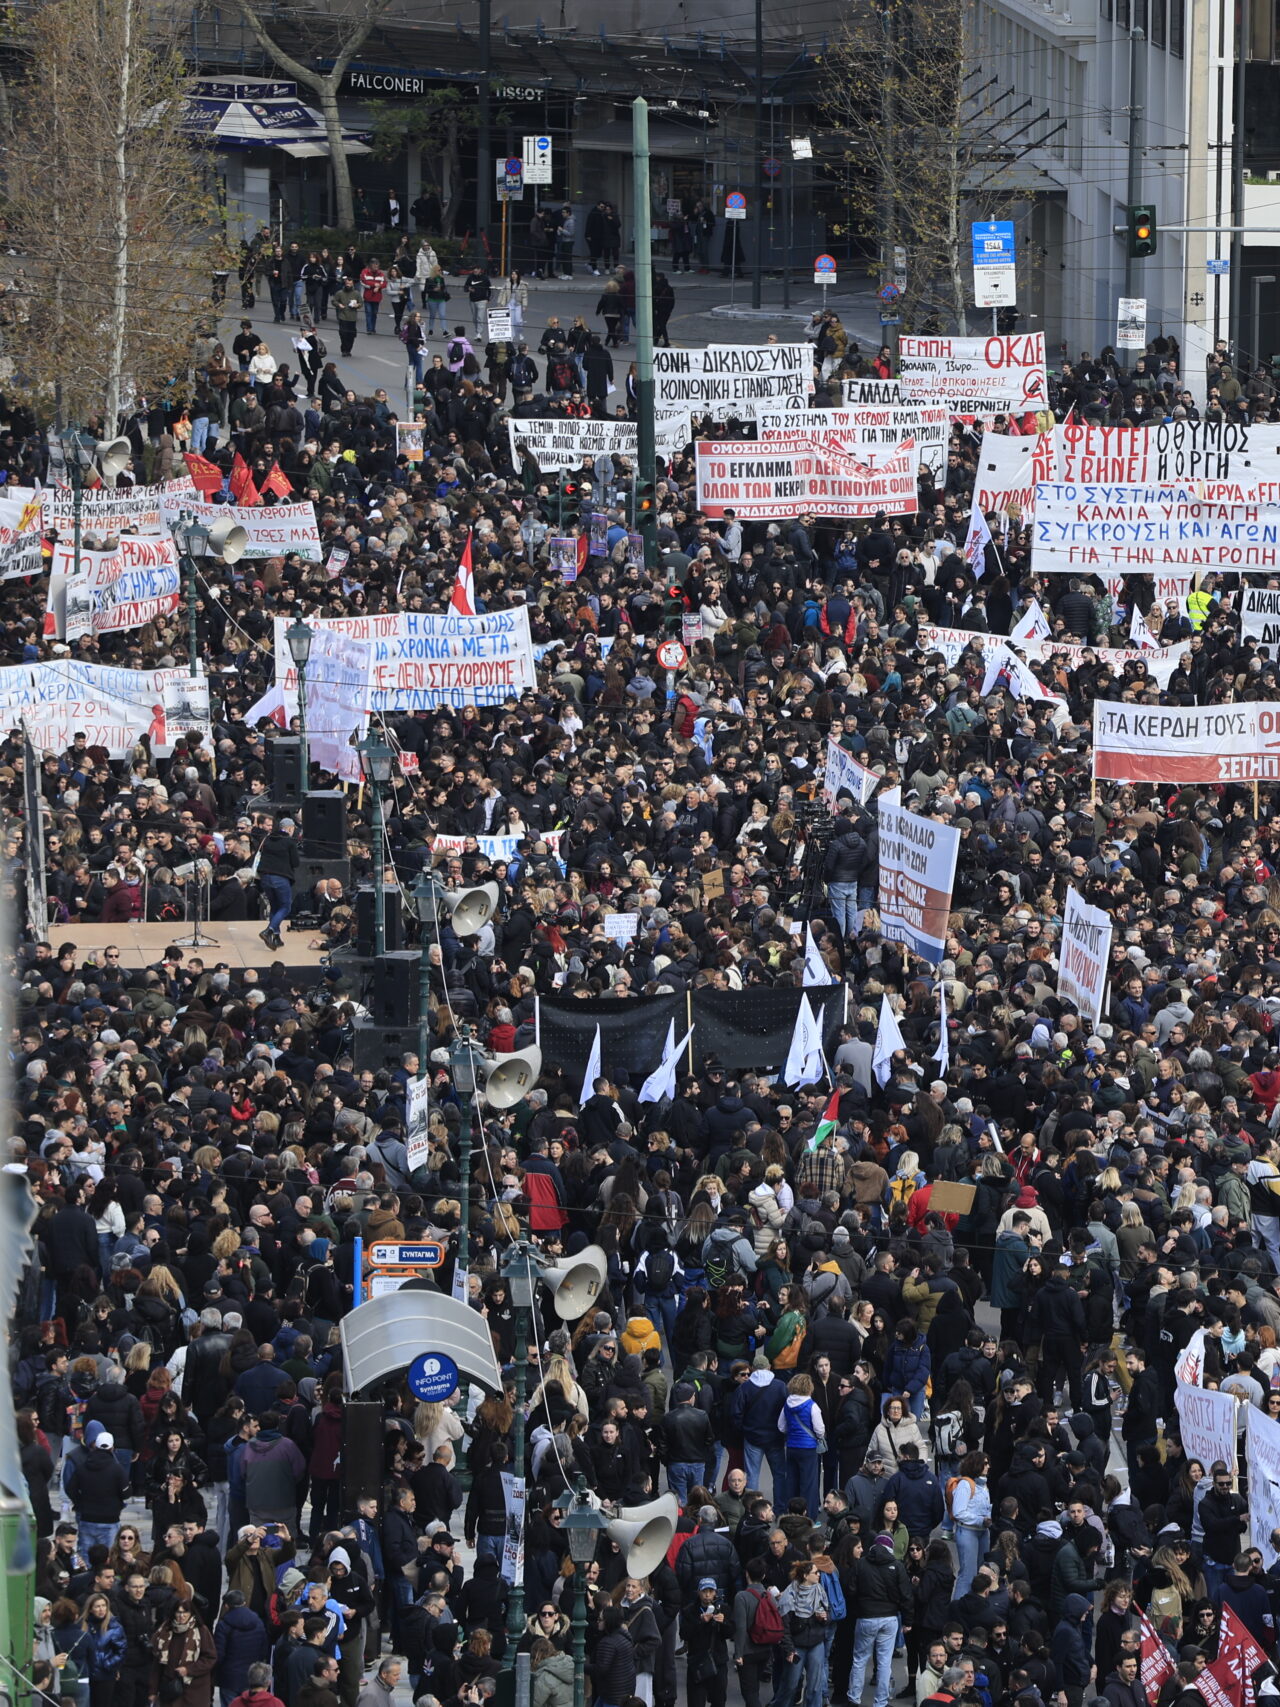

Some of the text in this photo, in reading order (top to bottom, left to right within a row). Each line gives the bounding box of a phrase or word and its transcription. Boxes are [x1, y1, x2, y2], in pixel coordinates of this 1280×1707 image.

[351, 72, 424, 94] FALCONERI
[261, 108, 302, 126] motion
[703, 347, 802, 373] ΔΙΚΑΙΟΣΥΝΗ
[985, 334, 1044, 369] ΟΚΔΕ
[660, 373, 803, 400] ΚΟΙΝΩΝΙΚΗ ΕΠΑΝΑΣΤΑΣΗ
[762, 415, 781, 428] ΣΤΟ
[784, 413, 828, 428] ΣΥΣΤΗΜΑ
[831, 412, 849, 426] ΤΟΥ
[854, 411, 890, 426] ΚΕΡΔΟΥΣ
[893, 410, 919, 425] ΚΑΜΙΑ
[579, 437, 607, 450] ΚΟΣΜΟΣ
[862, 428, 877, 443] ΓΙΑ
[880, 427, 897, 443] ΤΗΝ
[1064, 425, 1149, 456] ΦΕΥΓΕΙ
[1157, 424, 1169, 453] Ο
[1174, 421, 1249, 452] ΘΥΜΟΣ
[711, 440, 797, 454] ΟΜΟΣΠΟΝΔΙΑ
[709, 461, 792, 478] ΤΟ ΕΓΚΛΗΜΑ
[1065, 456, 1149, 483] ΣΒΗΝΕΙ
[1158, 454, 1167, 480] Η
[1175, 452, 1230, 479] ΟΡΓΗ
[703, 476, 914, 499] ΟΛΩΝ ΤΩΝ ΘΑ ΓΙΝΟΥΜΕ ΦΩΝΗ
[1037, 484, 1188, 504] ΣΤΟ ΣΥΣΤΗΜΑ
[1077, 503, 1258, 522] ΚΑΜΙΑ ΥΠΟΤΑΓΗ
[290, 526, 320, 541] ΜΑΣ
[1037, 521, 1169, 542] ΣΥΓΚΡΟΥΣΗ
[1179, 520, 1210, 539] ΚΑΙ
[1069, 546, 1276, 566] ΓΙΑ ΤΗΝ ΑΝΑΤΡΟΠΗ
[407, 615, 417, 634] Η
[423, 616, 435, 635] ΟΙ
[440, 615, 476, 636] ΖΩΕΣ
[485, 612, 516, 634] ΜΑΣ
[397, 635, 509, 659] ΧΡΟΝΙΑ ΜΕΤΑ
[38, 684, 85, 701] ΚΕΡΔΗ
[393, 687, 466, 711] ΣΥΛΛΟΓΟΙ
[72, 702, 110, 718] ΖΩΗ
[1107, 712, 1129, 734] ΤΑ
[1134, 714, 1198, 738] ΚΕΡΔΗ
[1204, 712, 1247, 736] ΤΟΥΣ
[1259, 711, 1280, 734] ΟΙ
[1218, 755, 1279, 779] ΣΕΤΗΠ
[402, 1250, 435, 1259] ΣΥΝΤΑΓΜΑ
[415, 1372, 453, 1387] INFO POINT
[419, 1382, 450, 1393] Syntagma
